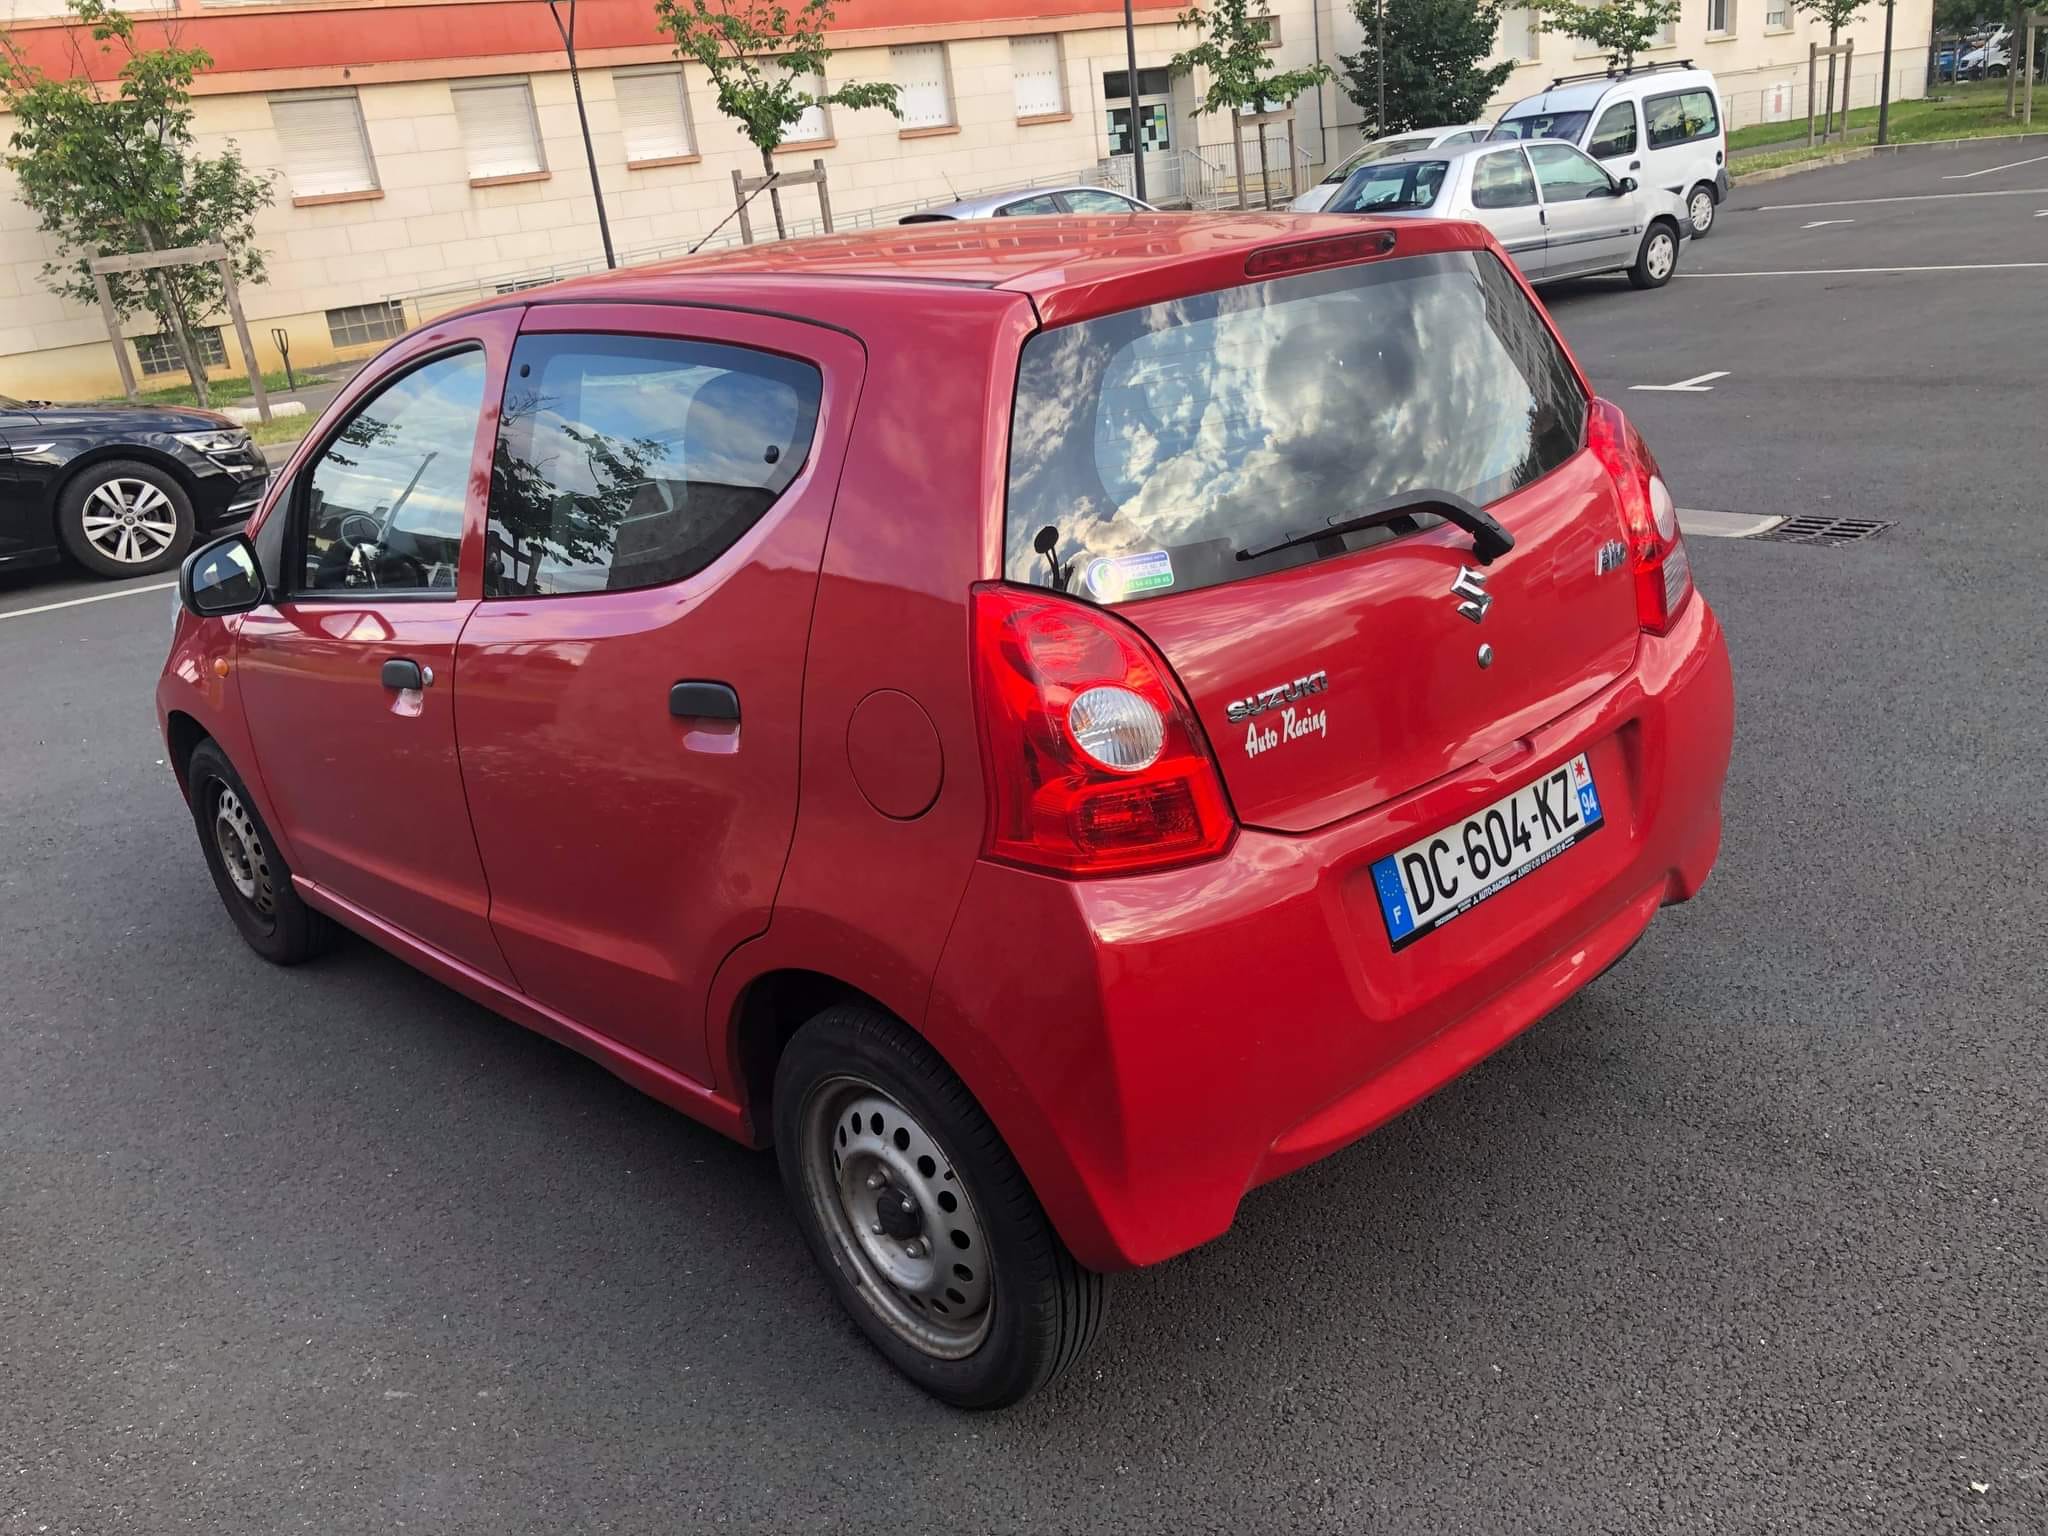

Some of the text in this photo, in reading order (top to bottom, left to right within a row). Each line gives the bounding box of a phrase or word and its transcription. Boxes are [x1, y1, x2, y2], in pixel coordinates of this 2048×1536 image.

[1227, 671, 1328, 722] SUZUKI
[1245, 707, 1326, 758] Auto Racing
[1581, 788, 1597, 816] 94
[1402, 769, 1579, 915] DC-604-KZ
[1393, 905, 1401, 925] F
